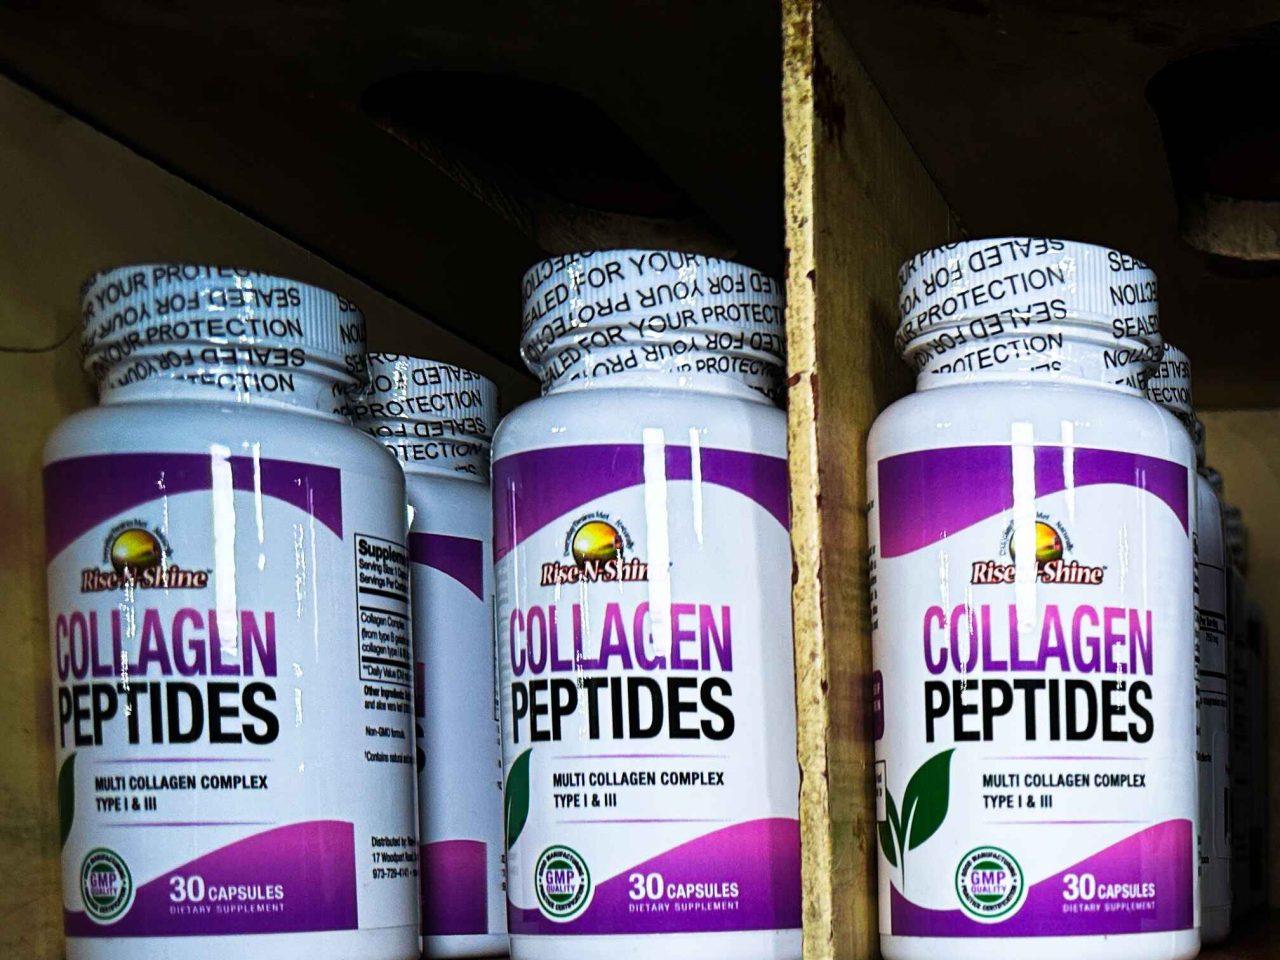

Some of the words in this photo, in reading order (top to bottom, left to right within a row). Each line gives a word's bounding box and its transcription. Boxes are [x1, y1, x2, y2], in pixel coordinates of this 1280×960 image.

[709, 274, 744, 293] FOR
[916, 265, 1066, 331] PROTECTION
[146, 318, 303, 346] PROTECTION
[629, 309, 697, 337] YOUR
[200, 348, 305, 369] SEALED
[923, 604, 1153, 675] COLLAGEN
[58, 681, 280, 748] PEPTIDES
[511, 676, 735, 744] PEPTIDES
[924, 678, 1154, 744] PEPTIDES
[553, 772, 585, 787] MULTI
[589, 772, 656, 786] COLLAGEN
[660, 771, 724, 786] COMPLEX
[983, 774, 1020, 788] MULTI
[1024, 774, 1090, 788] COLLAGEN
[1094, 774, 1146, 788] COMPLEX
[554, 793, 580, 808] TYPE
[591, 793, 601, 807] &
[604, 793, 617, 807] III
[169, 875, 205, 902] 30
[208, 884, 285, 901] CAPSULES
[546, 871, 575, 884] GMP
[629, 872, 664, 900] 30
[667, 882, 739, 900] CAPSULES
[1063, 873, 1096, 901] 30
[1098, 882, 1155, 900] CAPSULES
[629, 903, 670, 913] DIETARY
[675, 901, 739, 912] SUPPLEMENT
